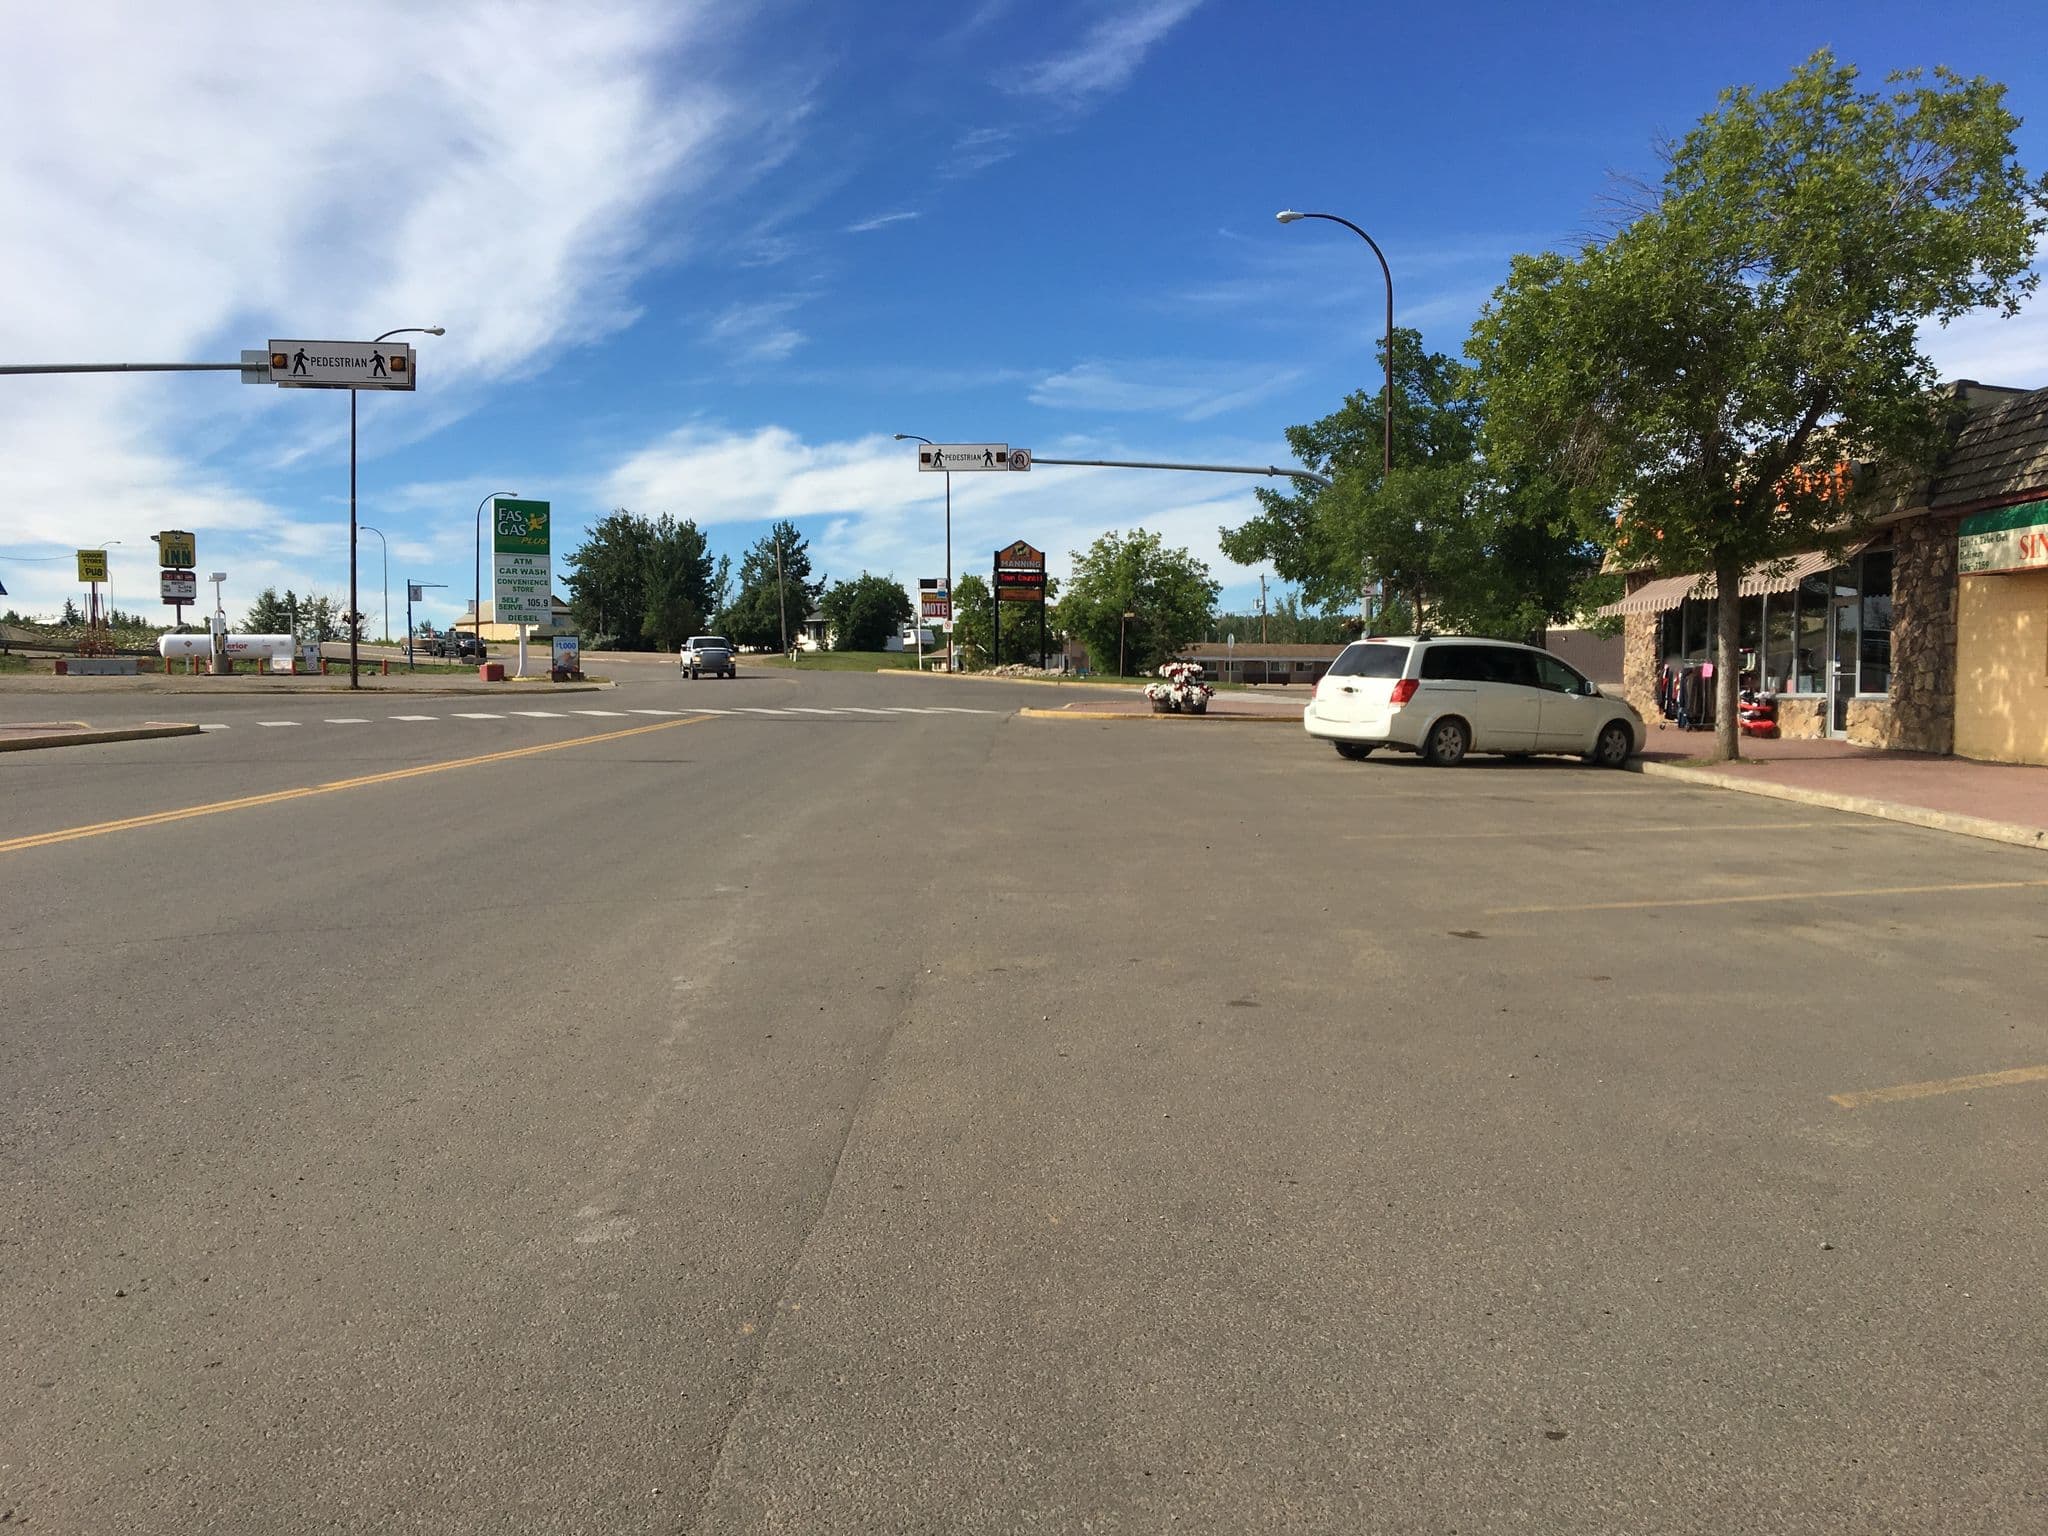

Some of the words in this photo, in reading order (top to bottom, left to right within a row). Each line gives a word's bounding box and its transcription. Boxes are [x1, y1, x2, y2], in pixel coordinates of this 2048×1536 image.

[310, 357, 367, 367] PEDESTRIAN
[944, 453, 982, 462] PEDESTRIAN
[498, 507, 522, 522] FAS
[498, 521, 526, 536] GAS
[1000, 560, 1041, 568] MANNING
[85, 567, 103, 577] PUB
[499, 567, 518, 575] CAR
[519, 568, 547, 576] WASH
[496, 578, 549, 586] CONVENIENCE
[501, 596, 519, 604] SELF
[507, 614, 540, 622] DIESEL
